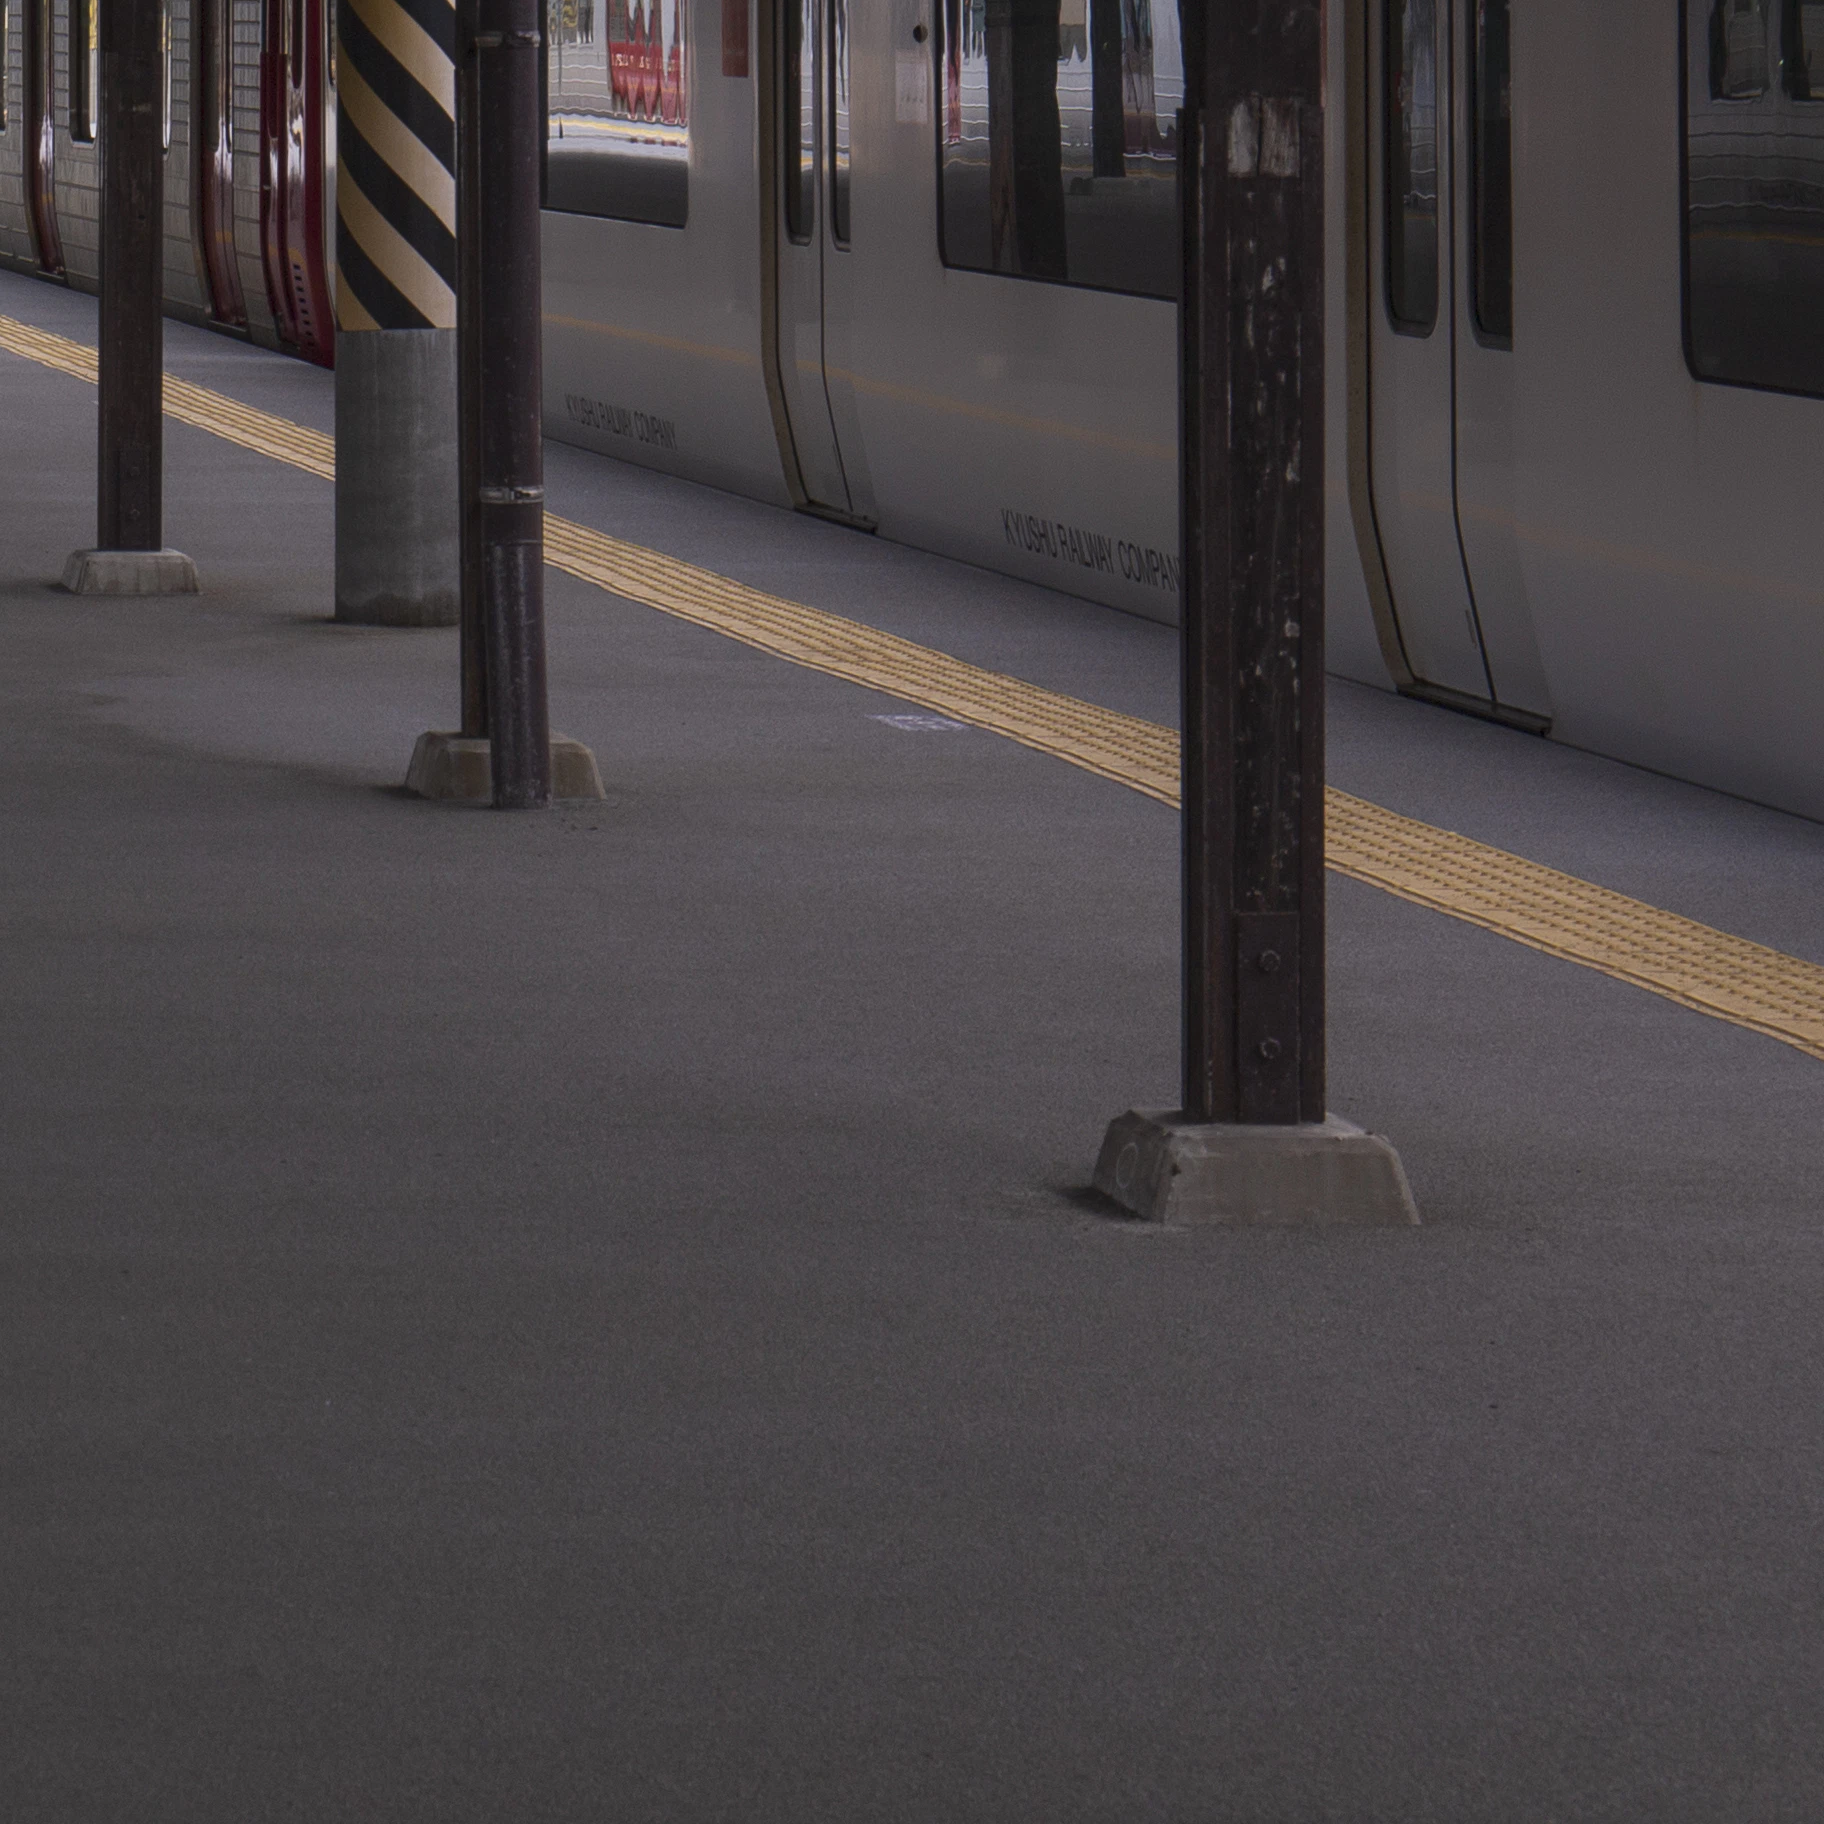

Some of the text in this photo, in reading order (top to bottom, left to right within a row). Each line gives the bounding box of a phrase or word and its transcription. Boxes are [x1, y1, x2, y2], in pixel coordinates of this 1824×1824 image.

[1001, 507, 1179, 592] KYUSHU RAILWAY COMPAN
